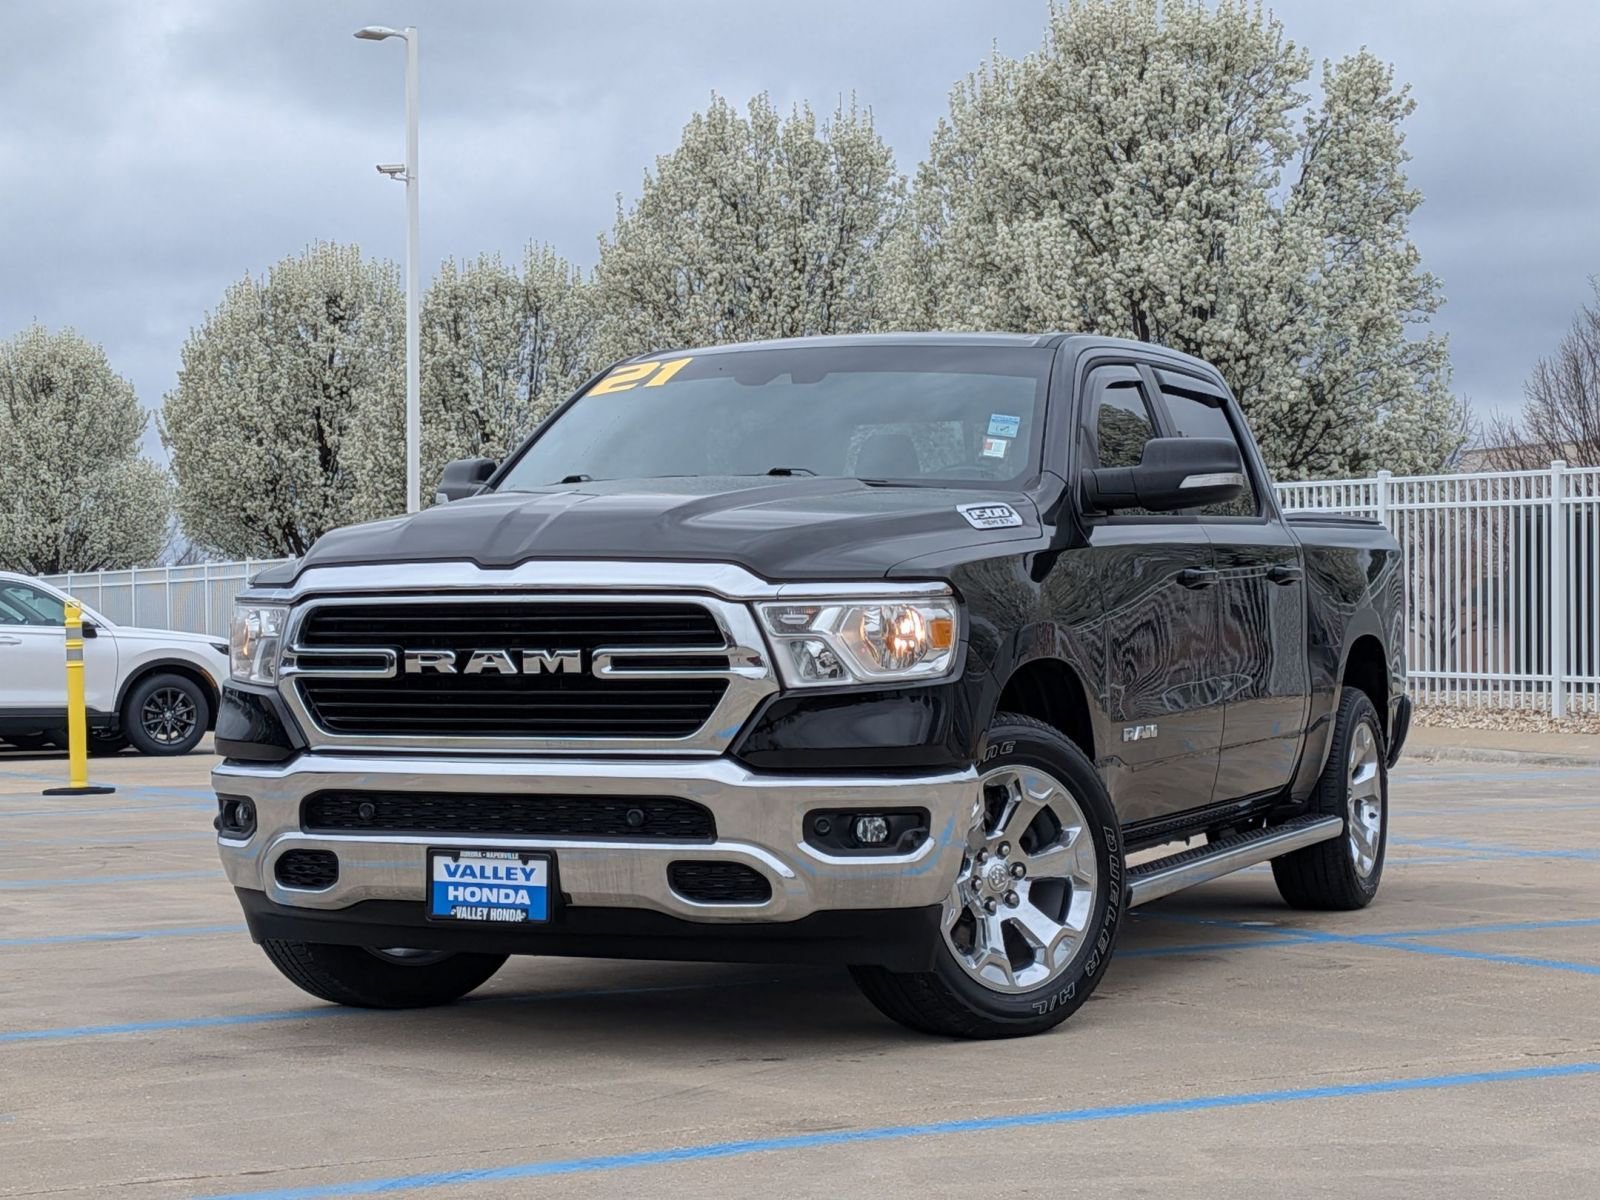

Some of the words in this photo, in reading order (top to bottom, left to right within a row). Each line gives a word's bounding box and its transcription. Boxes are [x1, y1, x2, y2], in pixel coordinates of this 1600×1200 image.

[587, 357, 694, 397] 21
[966, 505, 1012, 520] 1500
[404, 649, 582, 674] RAM
[1123, 724, 1158, 742] RAM
[443, 863, 536, 882] VALLEY
[447, 886, 531, 905] HONDA
[456, 906, 489, 921] VALLEY
[489, 907, 522, 922] HONDA
[1032, 981, 1076, 1015] H/L
